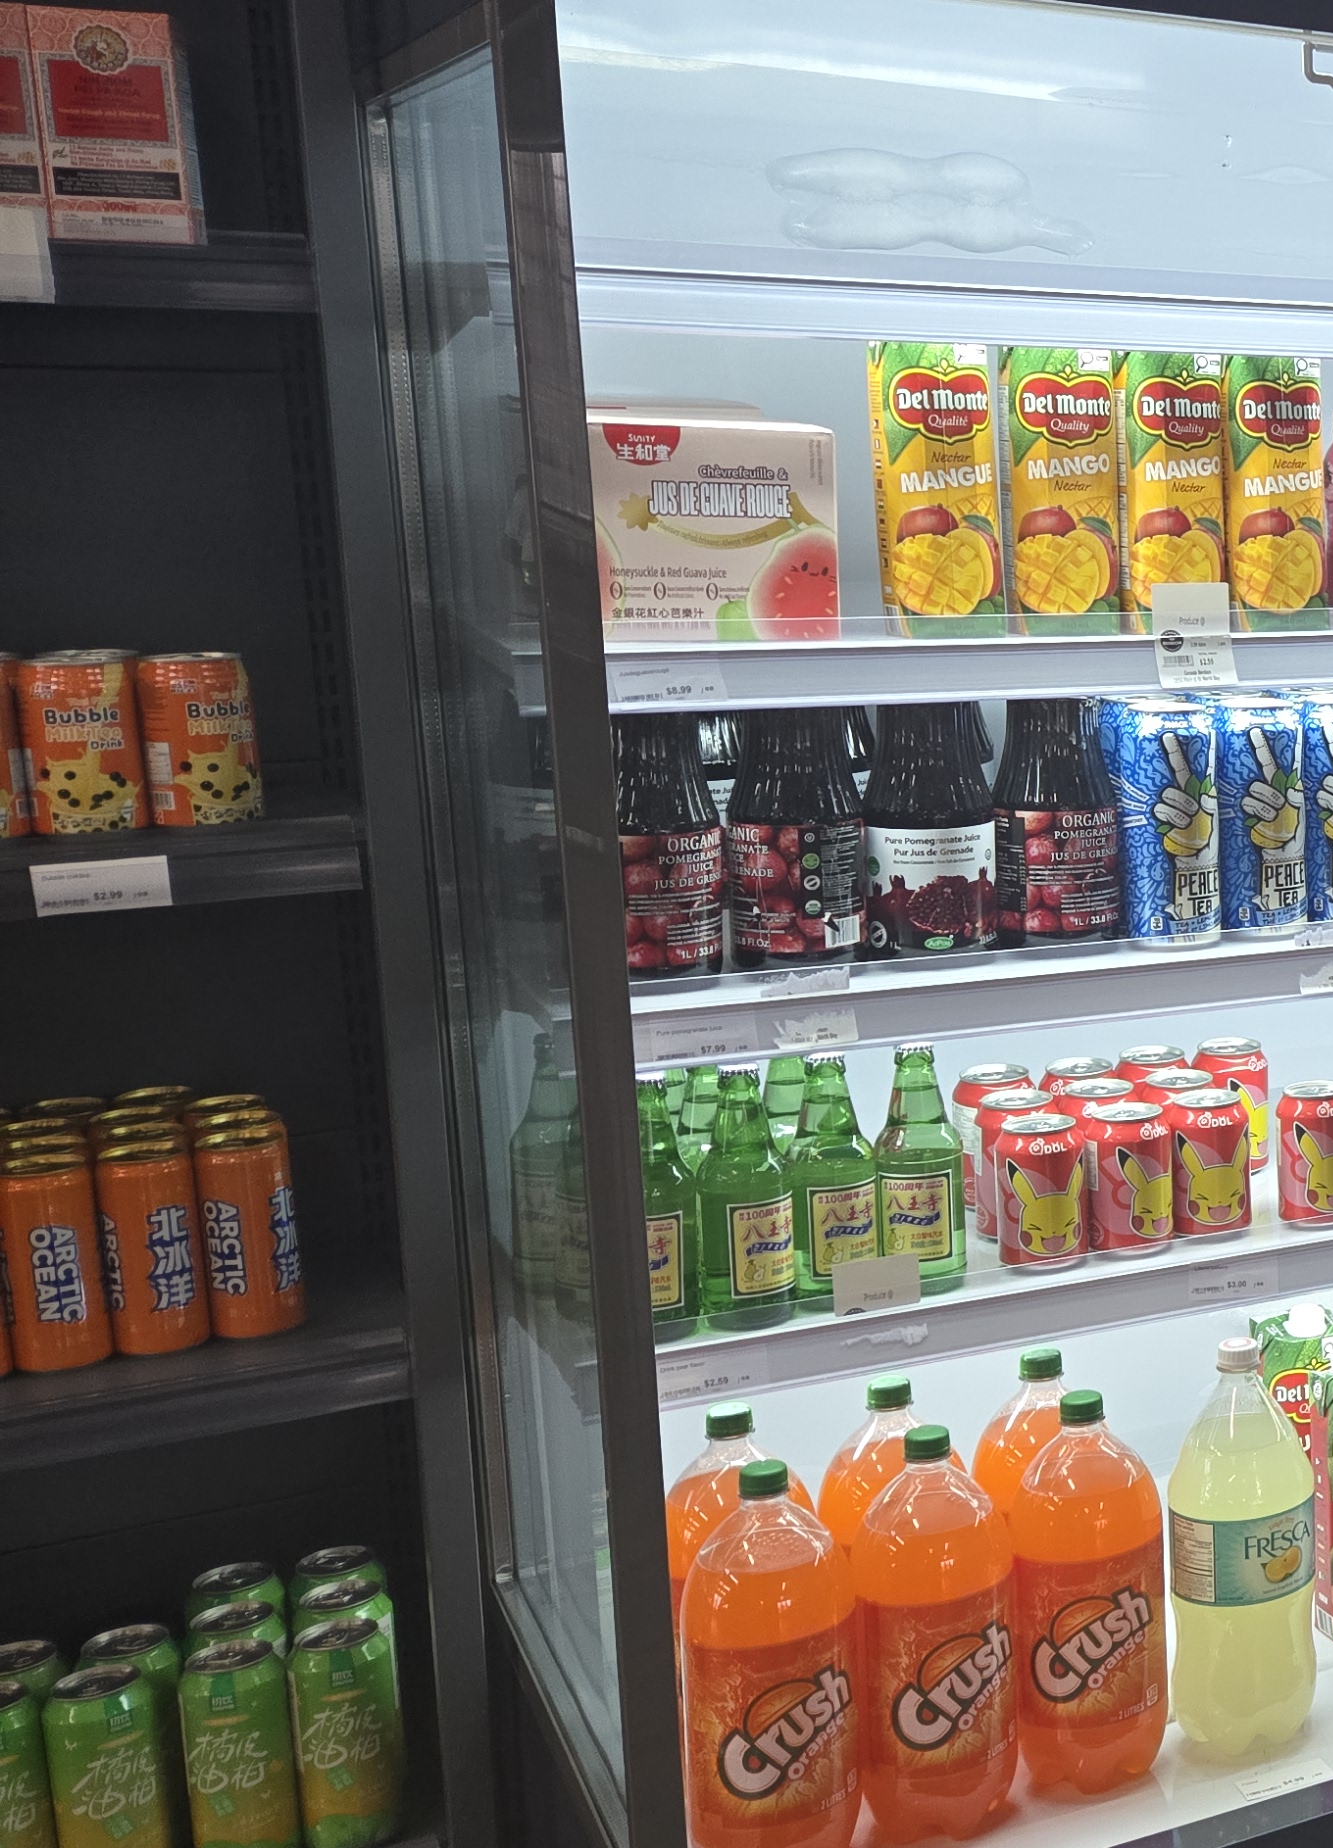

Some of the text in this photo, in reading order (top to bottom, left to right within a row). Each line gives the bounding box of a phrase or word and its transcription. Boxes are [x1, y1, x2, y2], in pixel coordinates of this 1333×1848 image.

[897, 388, 987, 412] Del Monte
[1022, 391, 1111, 417] Del Monte
[928, 412, 969, 430] Qualité
[1050, 418, 1090, 435] Quality
[616, 443, 671, 461] 生和堂
[931, 450, 971, 465] Nectar
[698, 464, 788, 480] Chèvrefeuille &
[1027, 453, 1110, 480] MANGO
[1145, 456, 1221, 482] MANGO
[900, 462, 992, 494] MANGUE
[1054, 479, 1092, 493] Nectar
[1244, 470, 1324, 498] MANGUE
[648, 480, 793, 518] JUS DE GUAVE ROUGE
[609, 566, 727, 579] Honeysuckle & Red Guava Juice
[666, 685, 692, 695] $8.99
[43, 706, 120, 726] Bubble
[186, 700, 251, 719] Bubble
[45, 727, 87, 743] Milk
[90, 739, 124, 751] Drink
[1062, 809, 1116, 828] ORGANIC
[885, 833, 981, 847] Pure Pomegranate Juice
[1054, 824, 1118, 840] POMEGRANA
[667, 831, 722, 853] ORGANIC
[894, 846, 974, 857] Pur Jus de Grenade
[1081, 837, 1106, 849] JUICE
[1051, 850, 1087, 862] JUS DE
[687, 860, 714, 874] JUICE
[654, 877, 694, 890] JUS DE
[93, 890, 123, 901] $2.99
[701, 1044, 726, 1055] $7.99
[886, 1193, 942, 1211] 八王寺
[203, 1200, 226, 1290] OCEAN
[217, 1201, 246, 1296] ARCTIC
[271, 1187, 301, 1292] 北冰洋
[102, 1214, 125, 1312] ARCTIC
[149, 1205, 196, 1312] 北冰洋
[29, 1228, 62, 1322] OCEAN
[50, 1225, 85, 1323] ARCTIC
[1226, 1279, 1247, 1290] $3.00
[1244, 1519, 1311, 1561] FRESCA
[1032, 1588, 1153, 1703] Crush
[1087, 1632, 1145, 1692] Orange
[893, 1621, 1012, 1751] Crush
[719, 1666, 851, 1800] Crush
[788, 1713, 845, 1782] Orange
